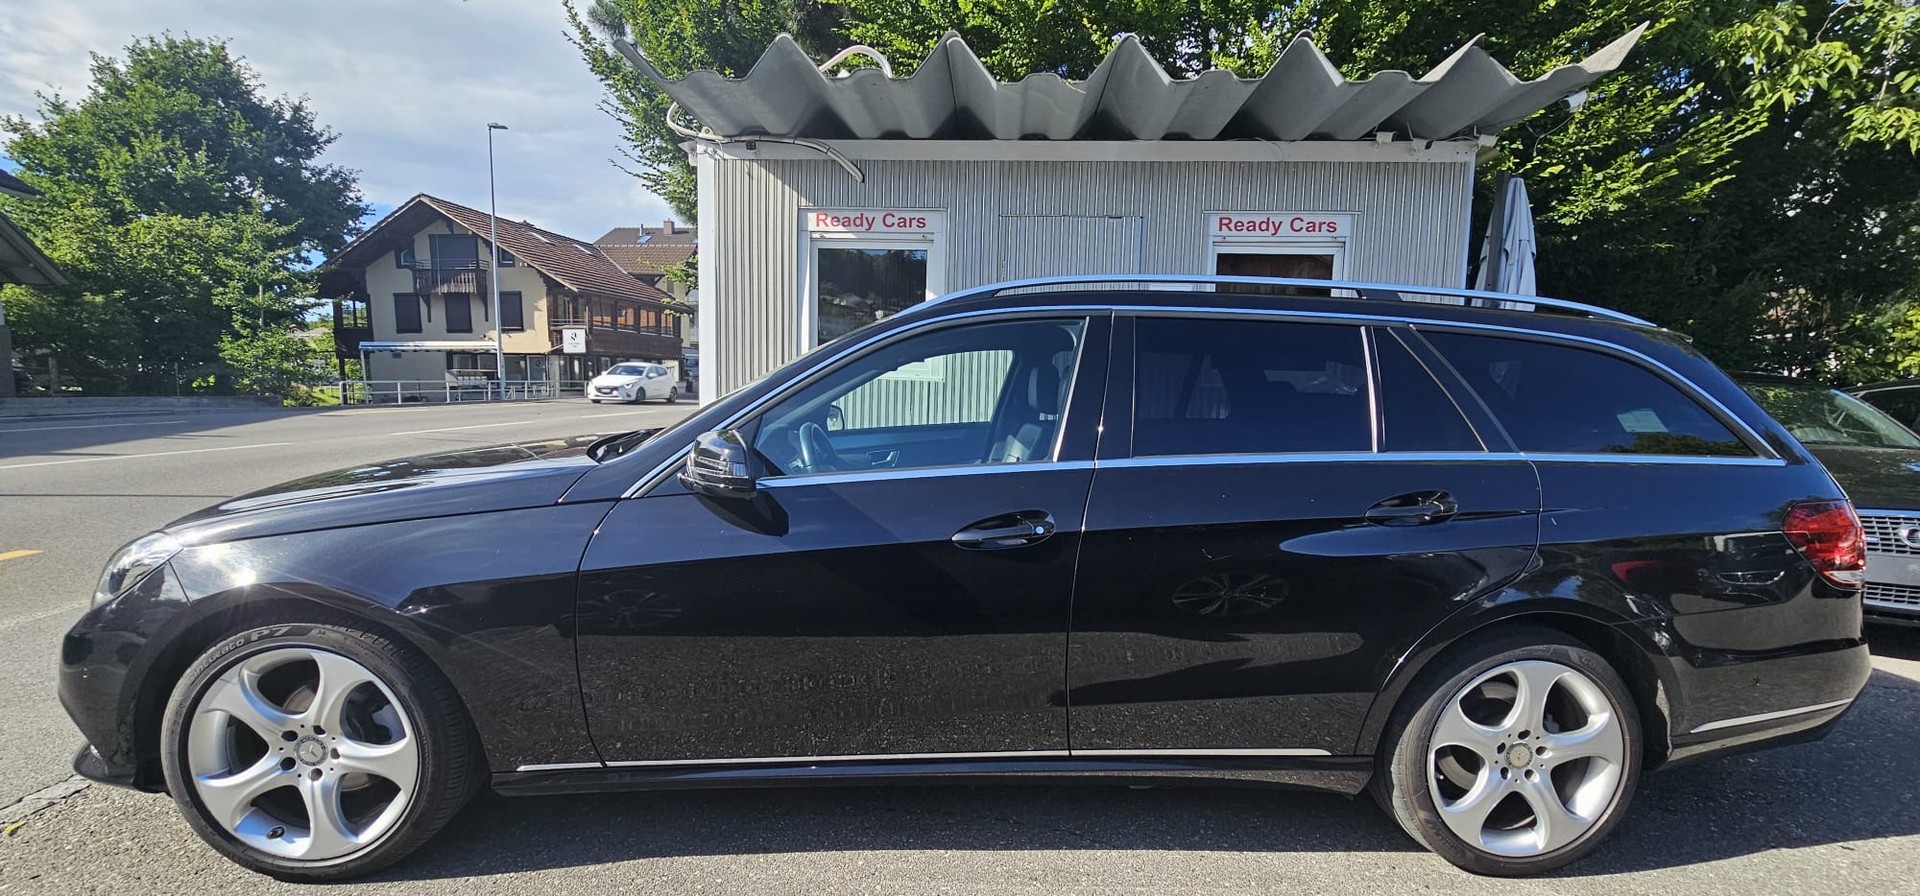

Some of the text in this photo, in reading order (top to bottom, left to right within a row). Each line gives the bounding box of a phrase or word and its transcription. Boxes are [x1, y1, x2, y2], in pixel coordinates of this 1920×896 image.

[815, 212, 927, 231] Ready Cars
[1218, 216, 1338, 236] Ready Cars
[250, 626, 292, 642] P7
